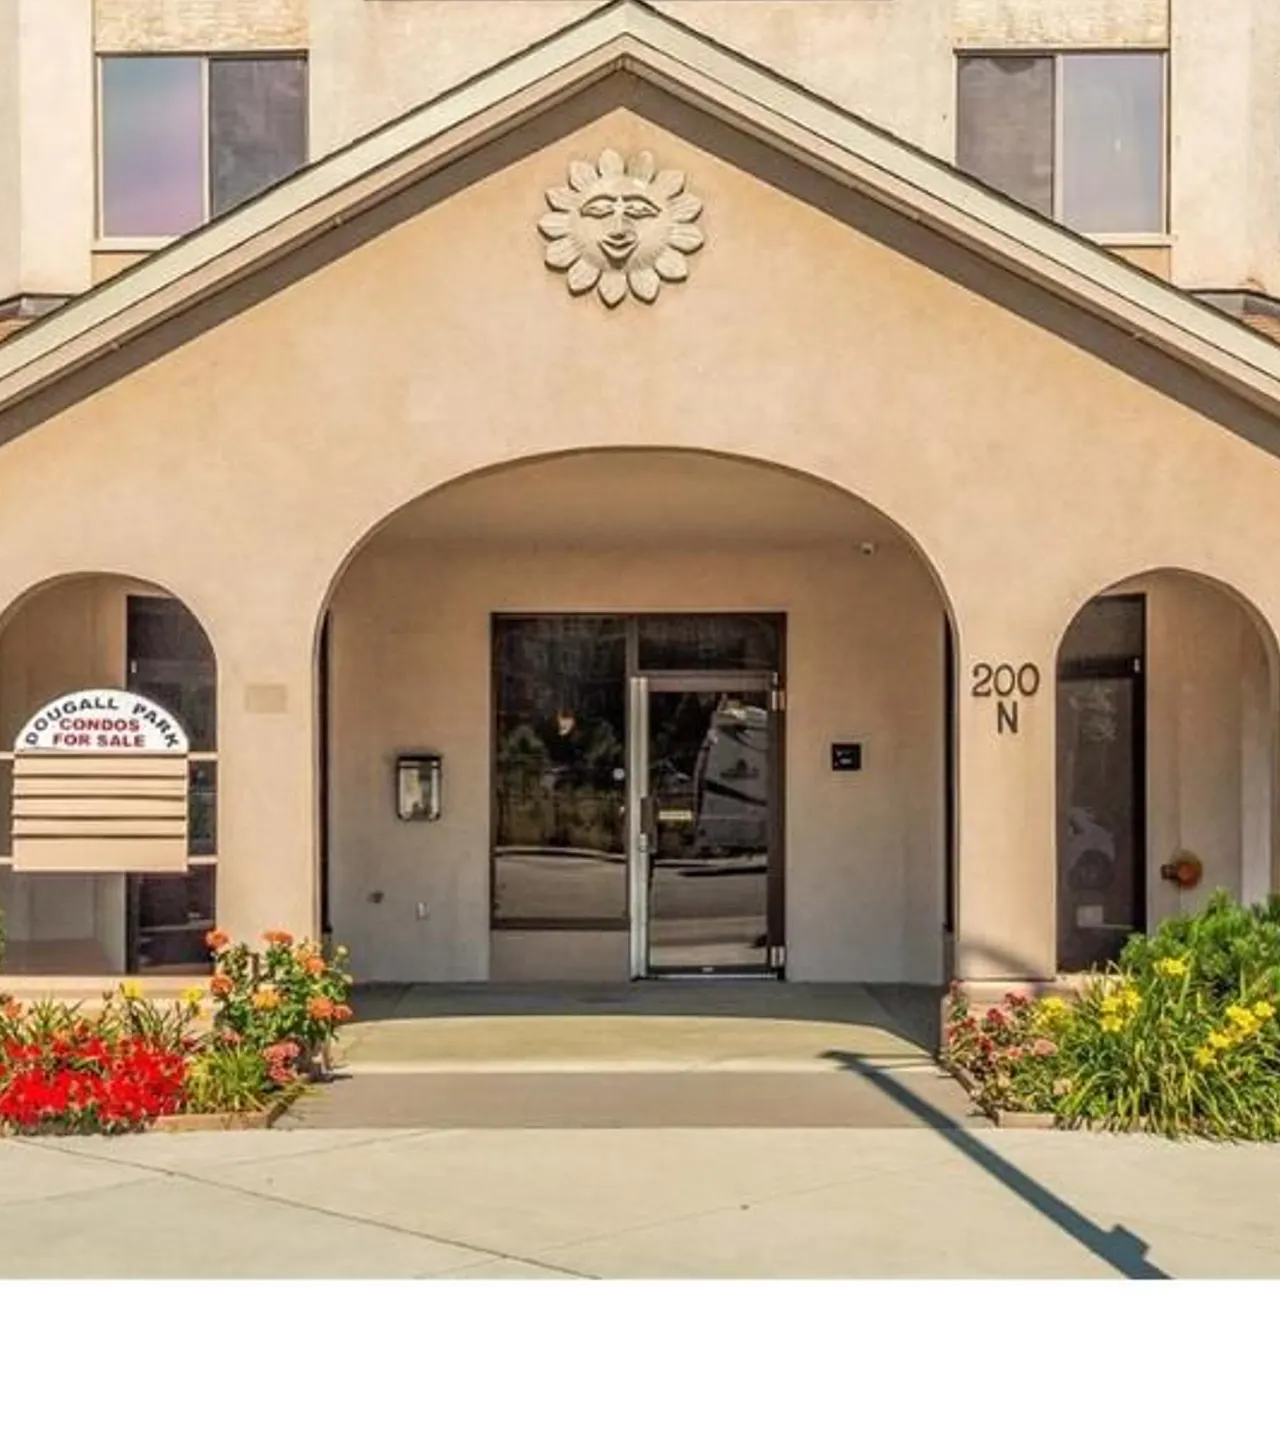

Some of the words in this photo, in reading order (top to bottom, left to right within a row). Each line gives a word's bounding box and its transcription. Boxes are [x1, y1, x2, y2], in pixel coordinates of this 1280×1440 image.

[971, 663, 1040, 698] 200
[25, 697, 119, 746] DOUGALL
[132, 703, 179, 748] PARK
[59, 718, 140, 732] CONDOS
[996, 701, 1018, 734] N
[52, 734, 90, 747] FOR
[96, 734, 145, 748] SALE
